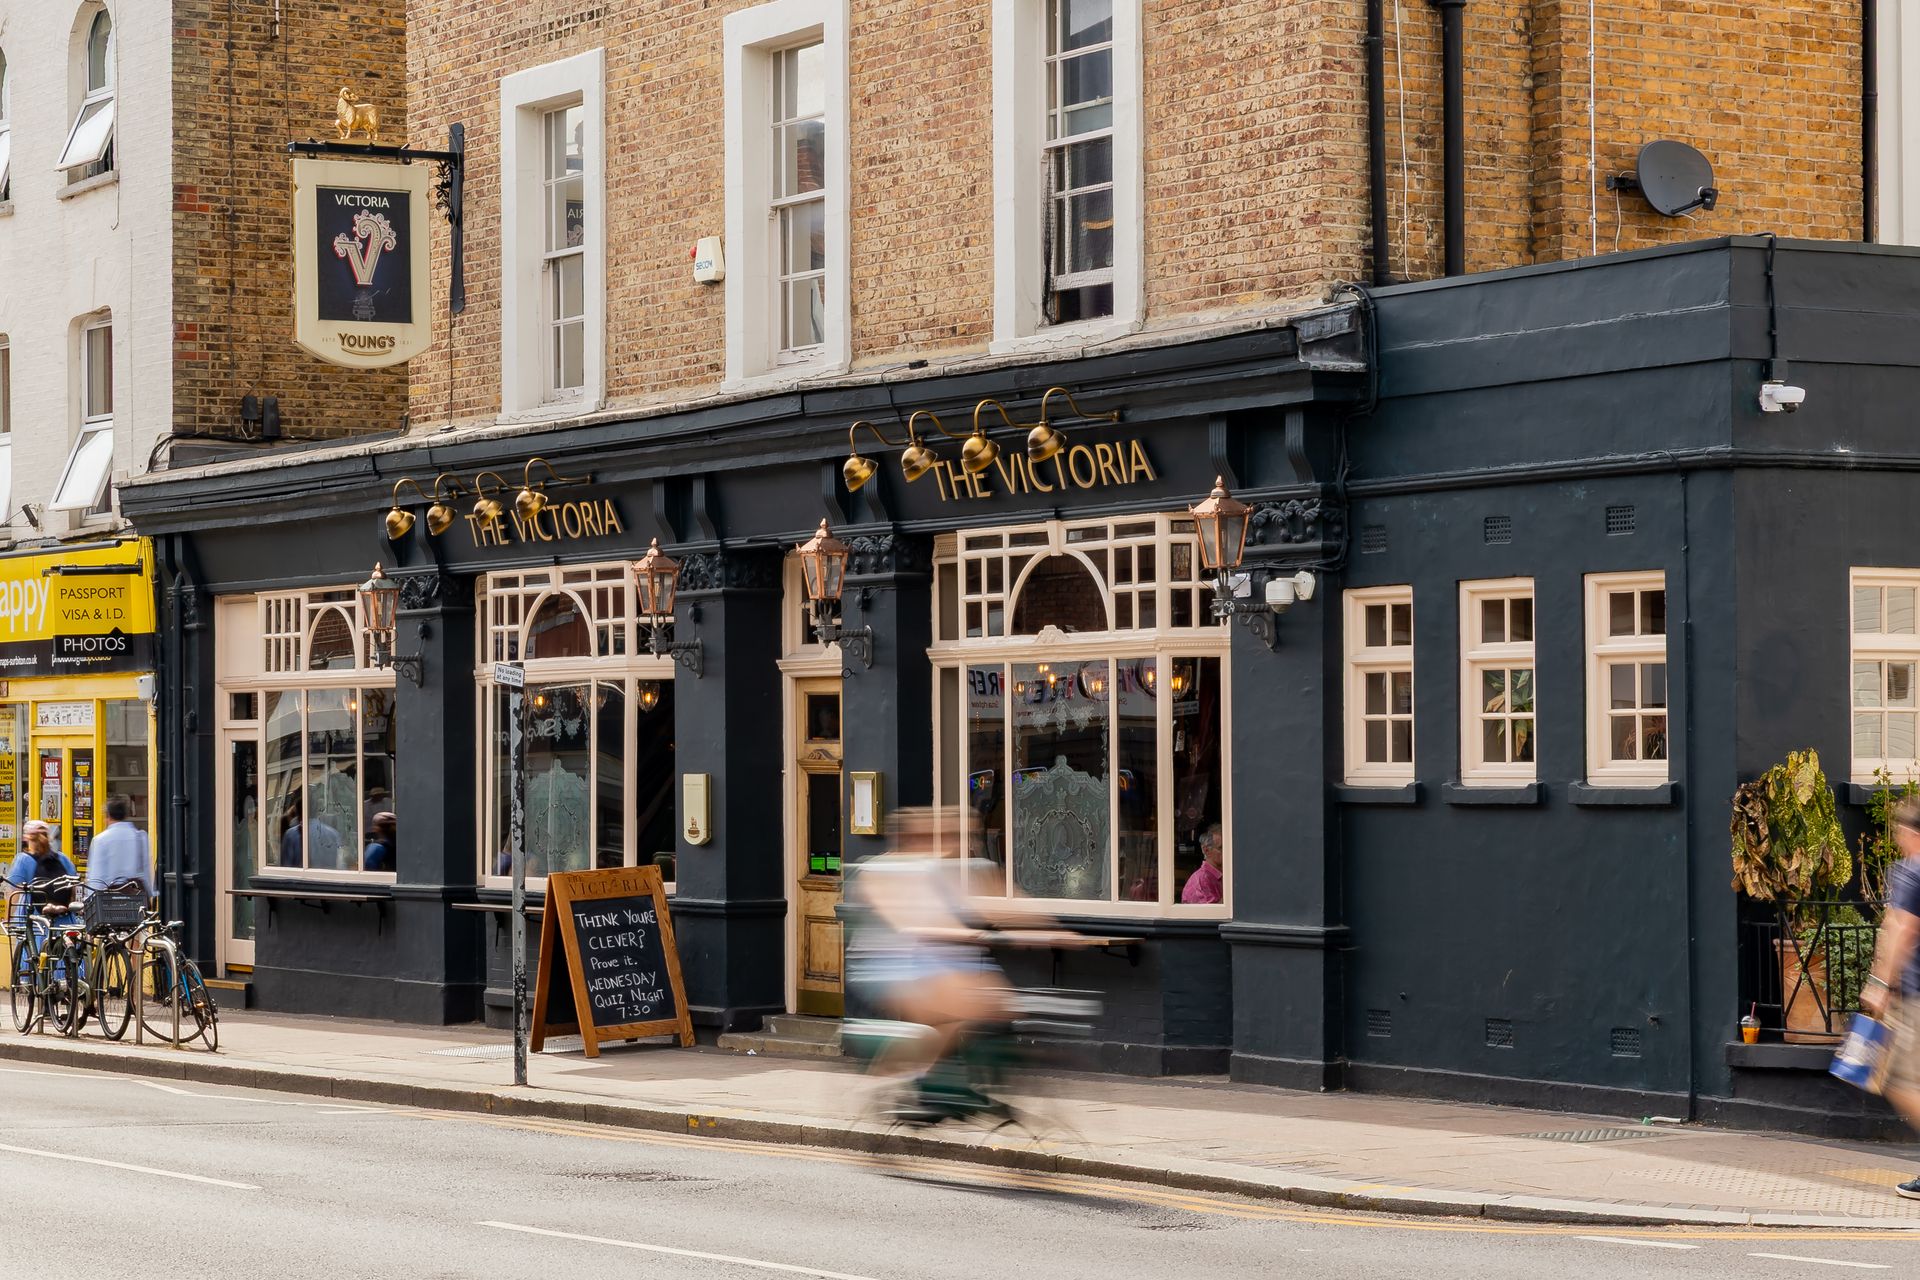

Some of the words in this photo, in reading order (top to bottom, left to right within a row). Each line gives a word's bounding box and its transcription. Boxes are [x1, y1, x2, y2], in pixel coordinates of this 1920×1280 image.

[334, 194, 390, 209] VICTORIA
[337, 332, 396, 349] YOUNG'S
[930, 458, 994, 501] THE
[994, 438, 1157, 495] VICTORIA
[463, 510, 511, 548] THE
[510, 498, 623, 544] VICTORIA
[60, 587, 126, 600] PASSPORT
[62, 608, 91, 620] VISA
[93, 608, 103, 620] &
[105, 607, 126, 620] I.D.
[63, 637, 126, 652] PHOTOS
[505, 669, 521, 677] loading
[511, 676, 522, 684] time
[45, 761, 59, 778] SALE
[574, 912, 620, 929] THINK
[588, 928, 646, 950] CLEVER?
[590, 956, 620, 970] Prove
[624, 955, 638, 966] it.
[587, 971, 656, 993] WEDNESDAY
[630, 988, 665, 1003] NIGHT
[616, 1005, 651, 1020] 7:30
